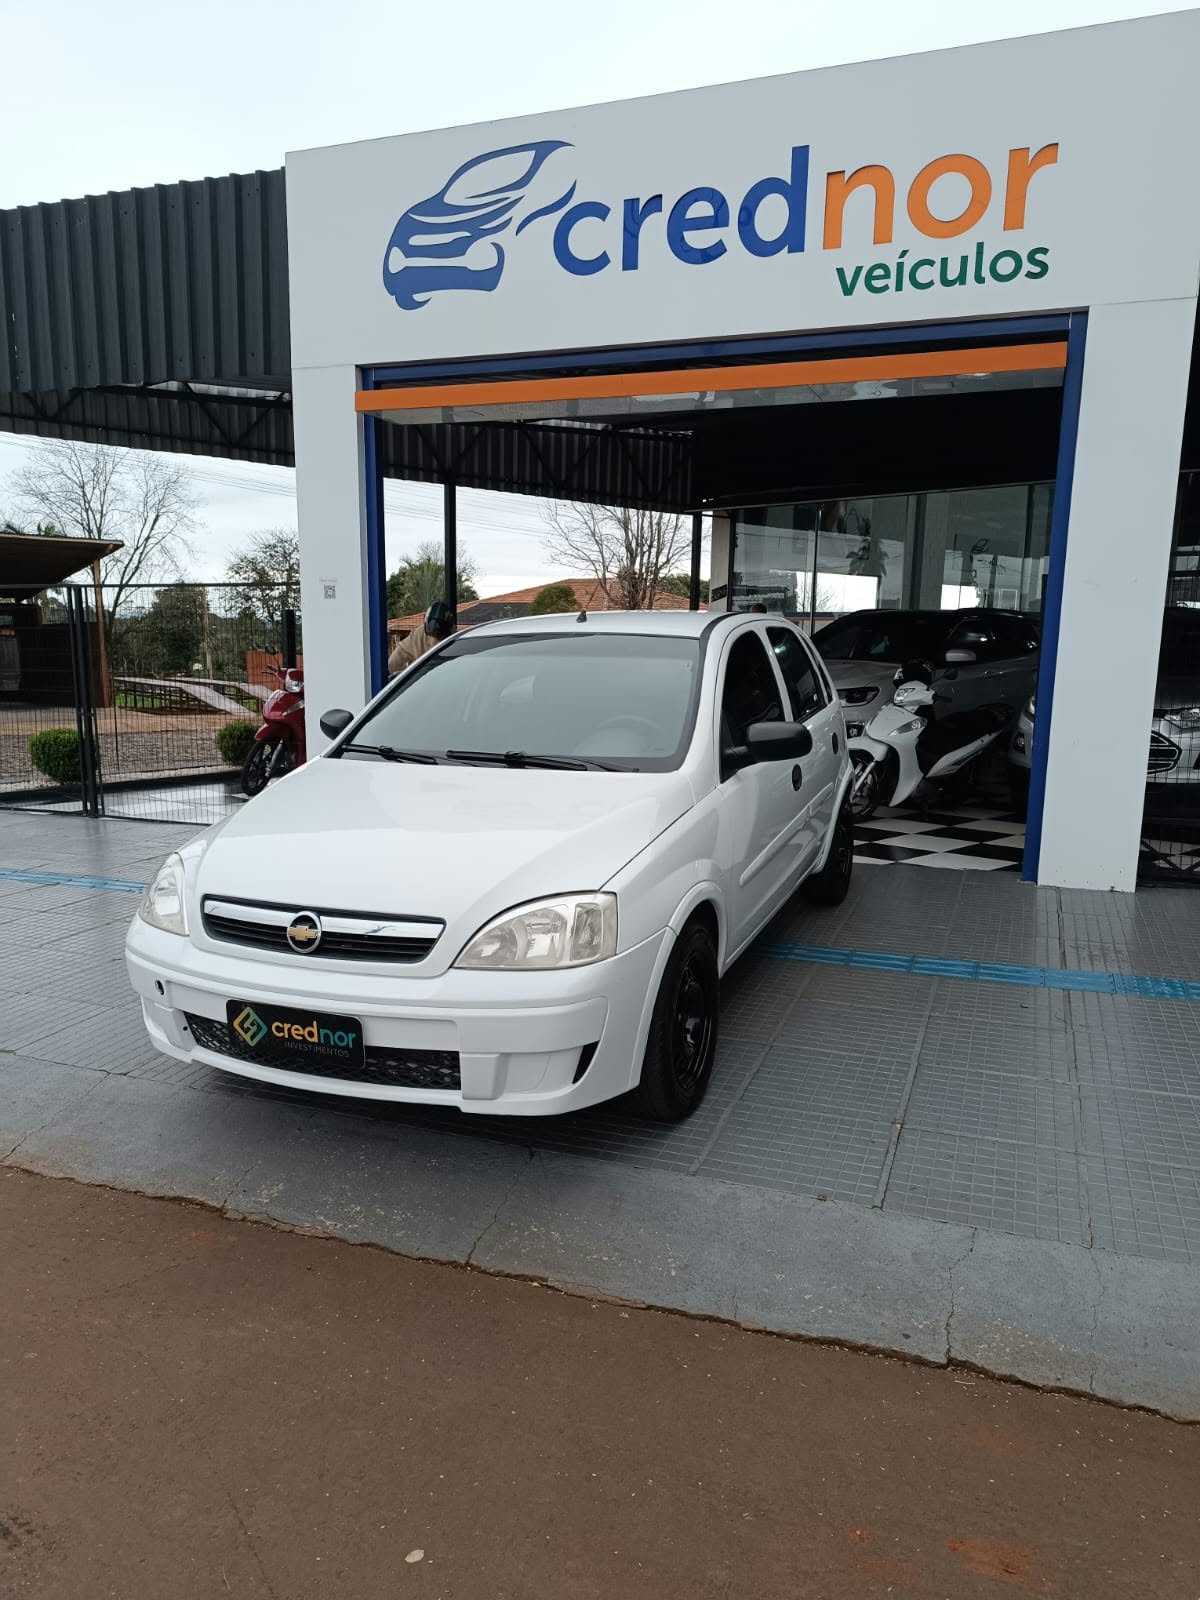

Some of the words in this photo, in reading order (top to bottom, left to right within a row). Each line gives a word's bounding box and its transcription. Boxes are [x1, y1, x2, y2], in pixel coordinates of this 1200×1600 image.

[552, 142, 1059, 275] crednor
[836, 242, 1050, 296] veículos
[271, 1021, 357, 1049] crednor
[284, 1040, 350, 1058] INVESTIMENTOS
